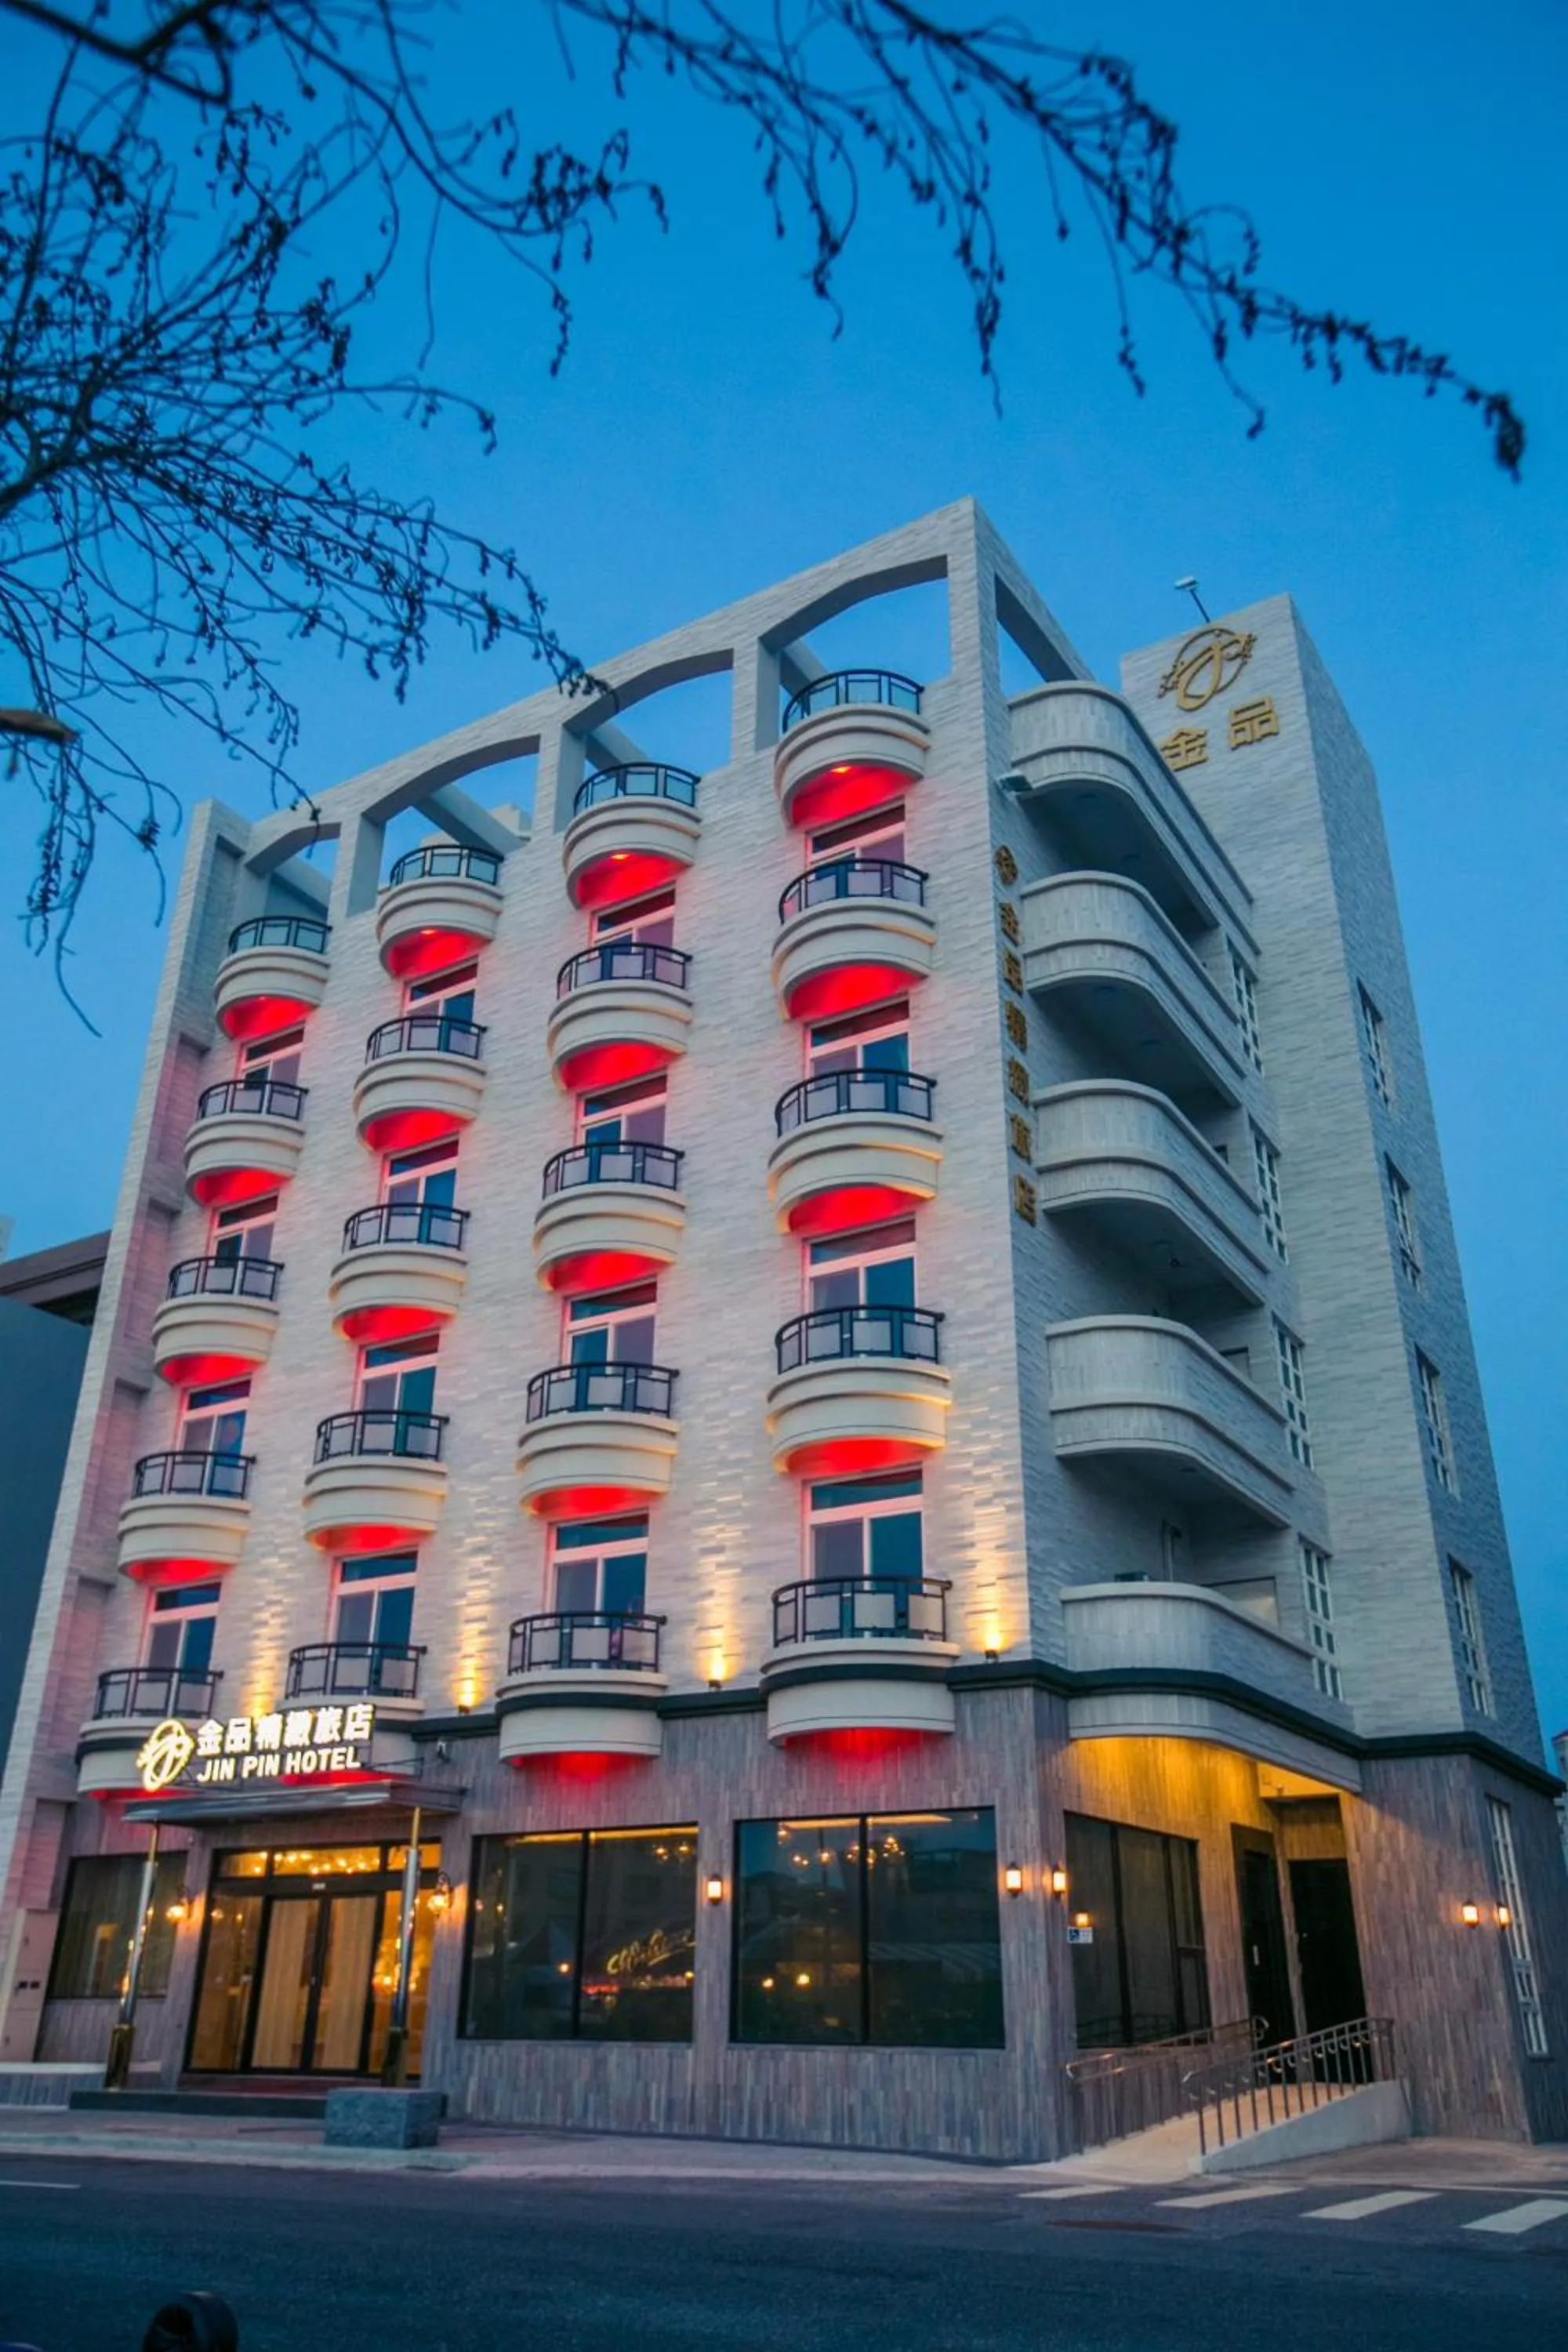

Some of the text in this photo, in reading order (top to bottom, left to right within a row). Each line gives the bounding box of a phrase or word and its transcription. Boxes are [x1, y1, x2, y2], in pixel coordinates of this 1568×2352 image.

[1160, 696, 1280, 771] 金品
[196, 1747, 361, 1782] JIN PIN HOTEL
